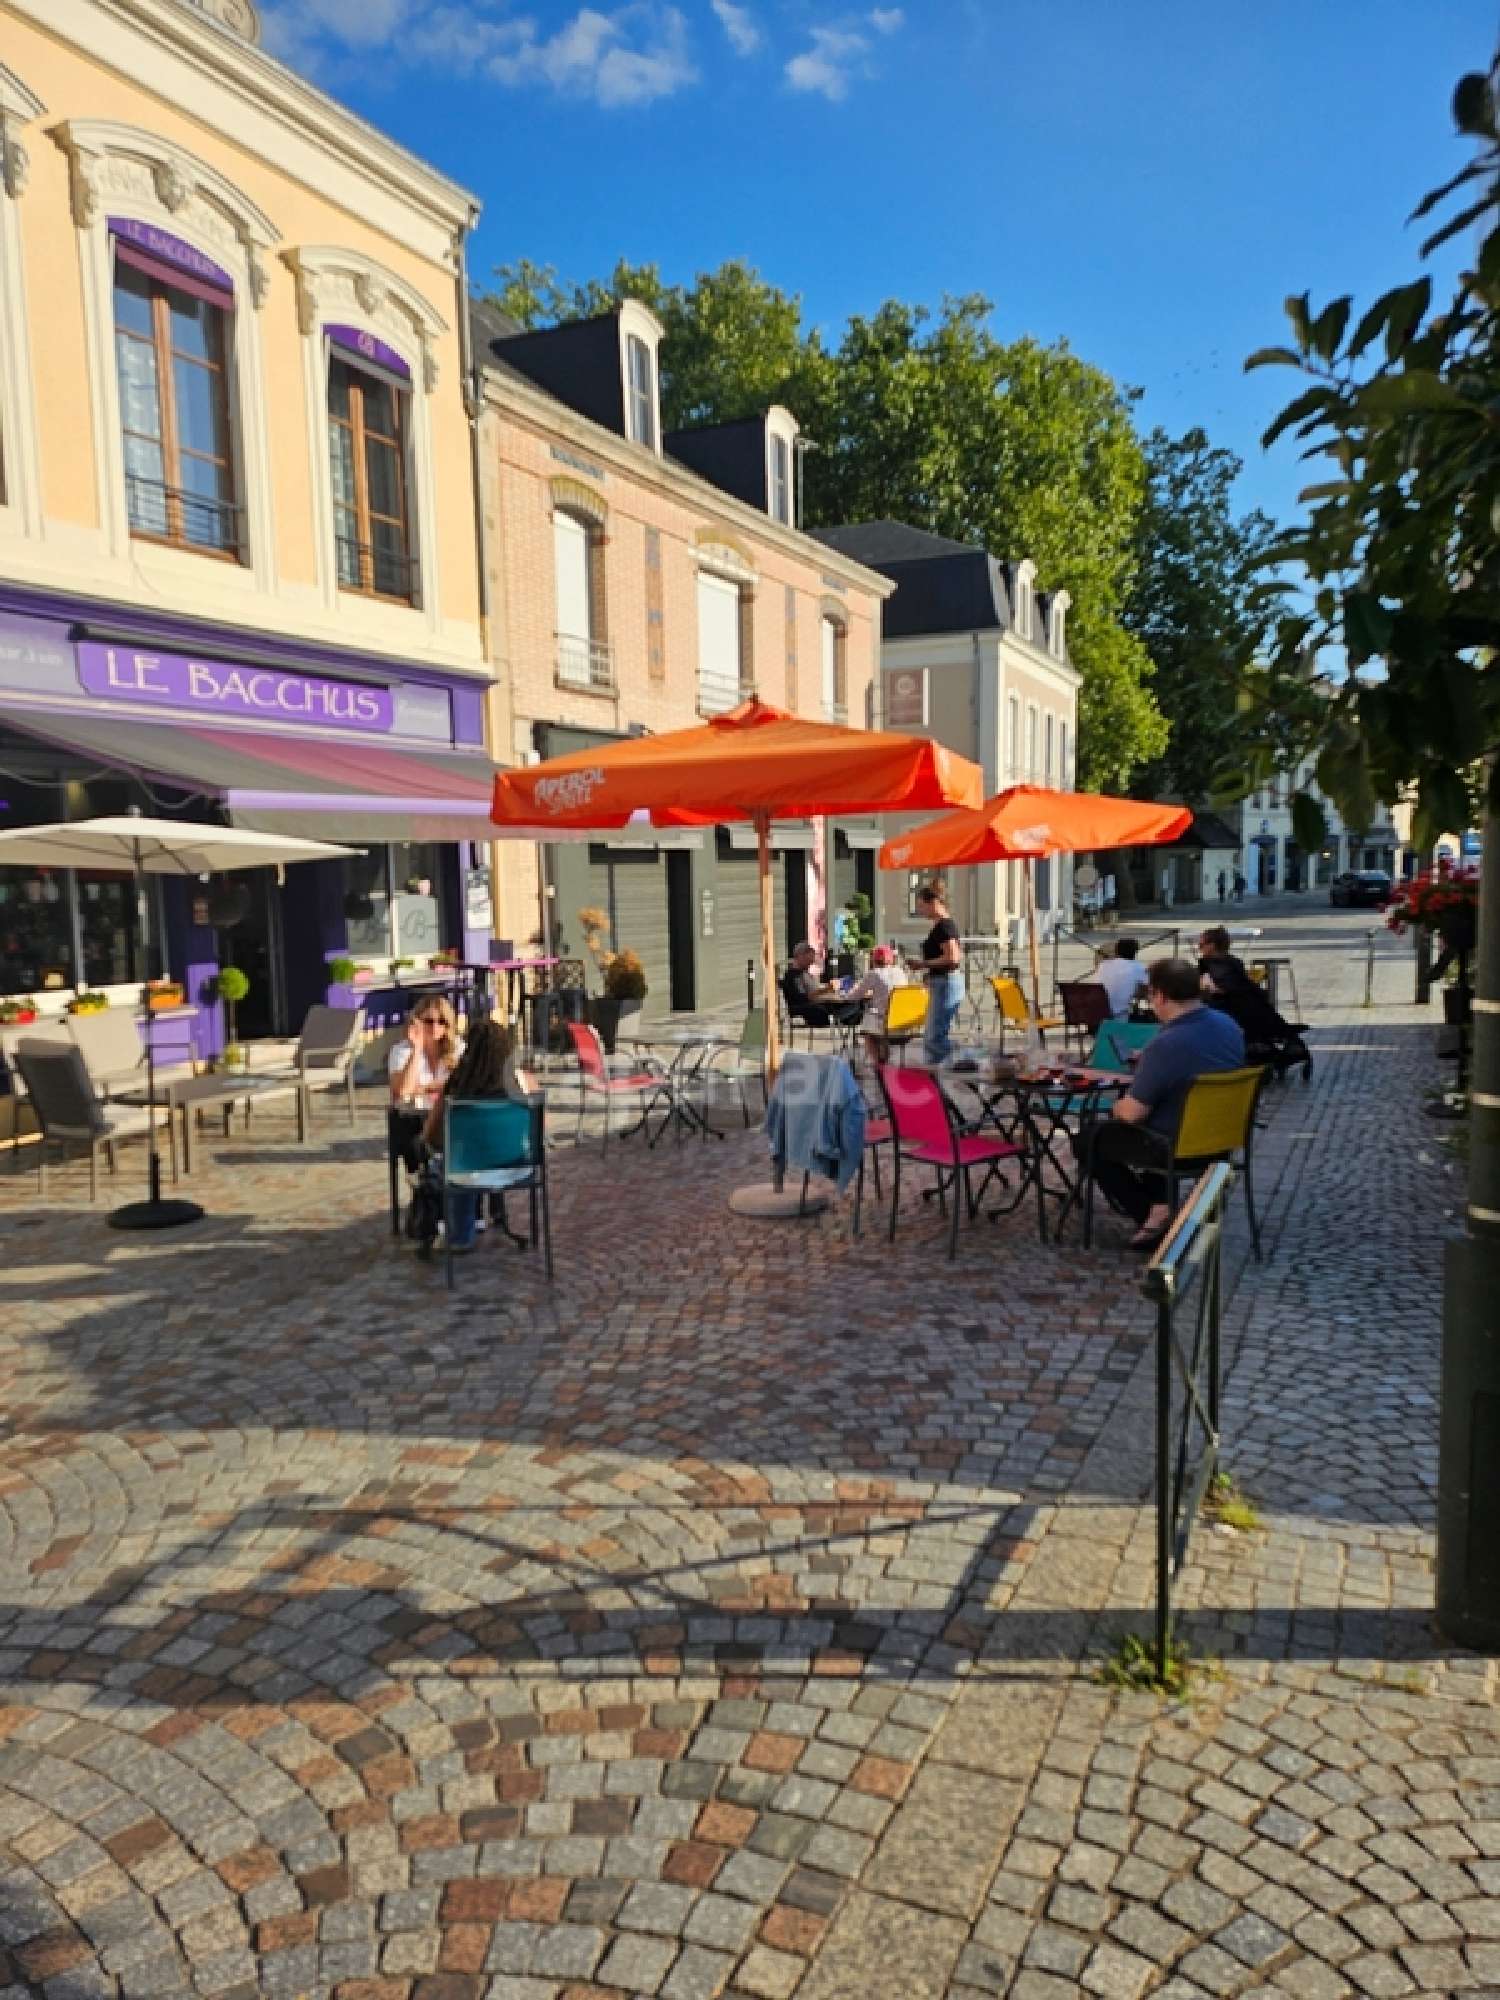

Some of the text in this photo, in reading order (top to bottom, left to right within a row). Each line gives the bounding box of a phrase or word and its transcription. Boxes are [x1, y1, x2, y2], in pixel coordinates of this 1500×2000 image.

[105, 648, 170, 693] LE
[187, 662, 380, 721] BACCHUS
[533, 766, 607, 804] APEROL
